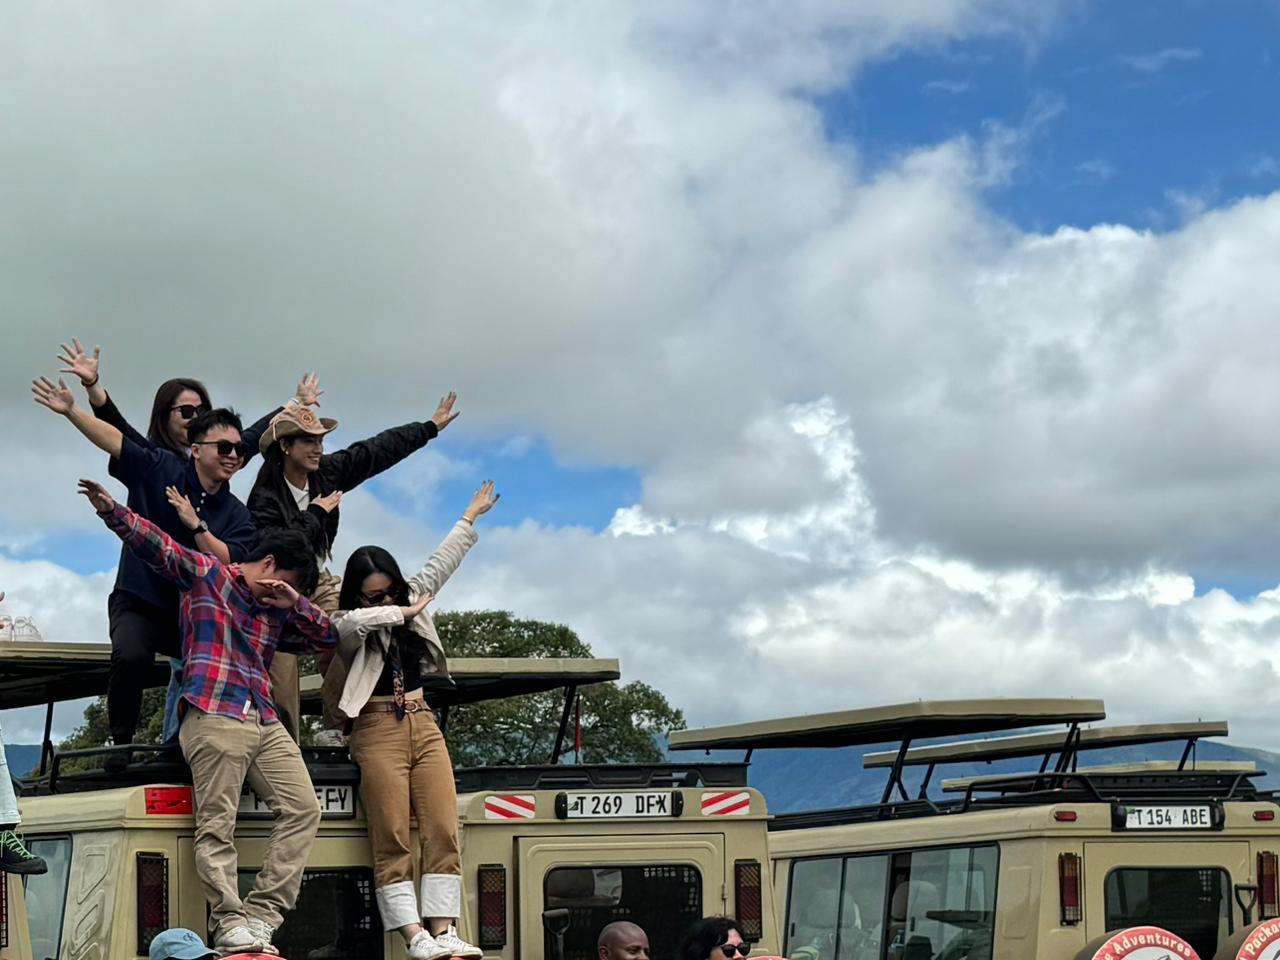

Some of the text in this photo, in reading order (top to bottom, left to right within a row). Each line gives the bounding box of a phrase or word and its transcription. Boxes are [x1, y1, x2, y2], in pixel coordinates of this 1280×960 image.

[577, 795, 667, 814] T 269 DFX
[1135, 808, 1208, 826] T 154 ABE
[1113, 933, 1192, 957] Adventures
[1245, 920, 1280, 956] Packa
